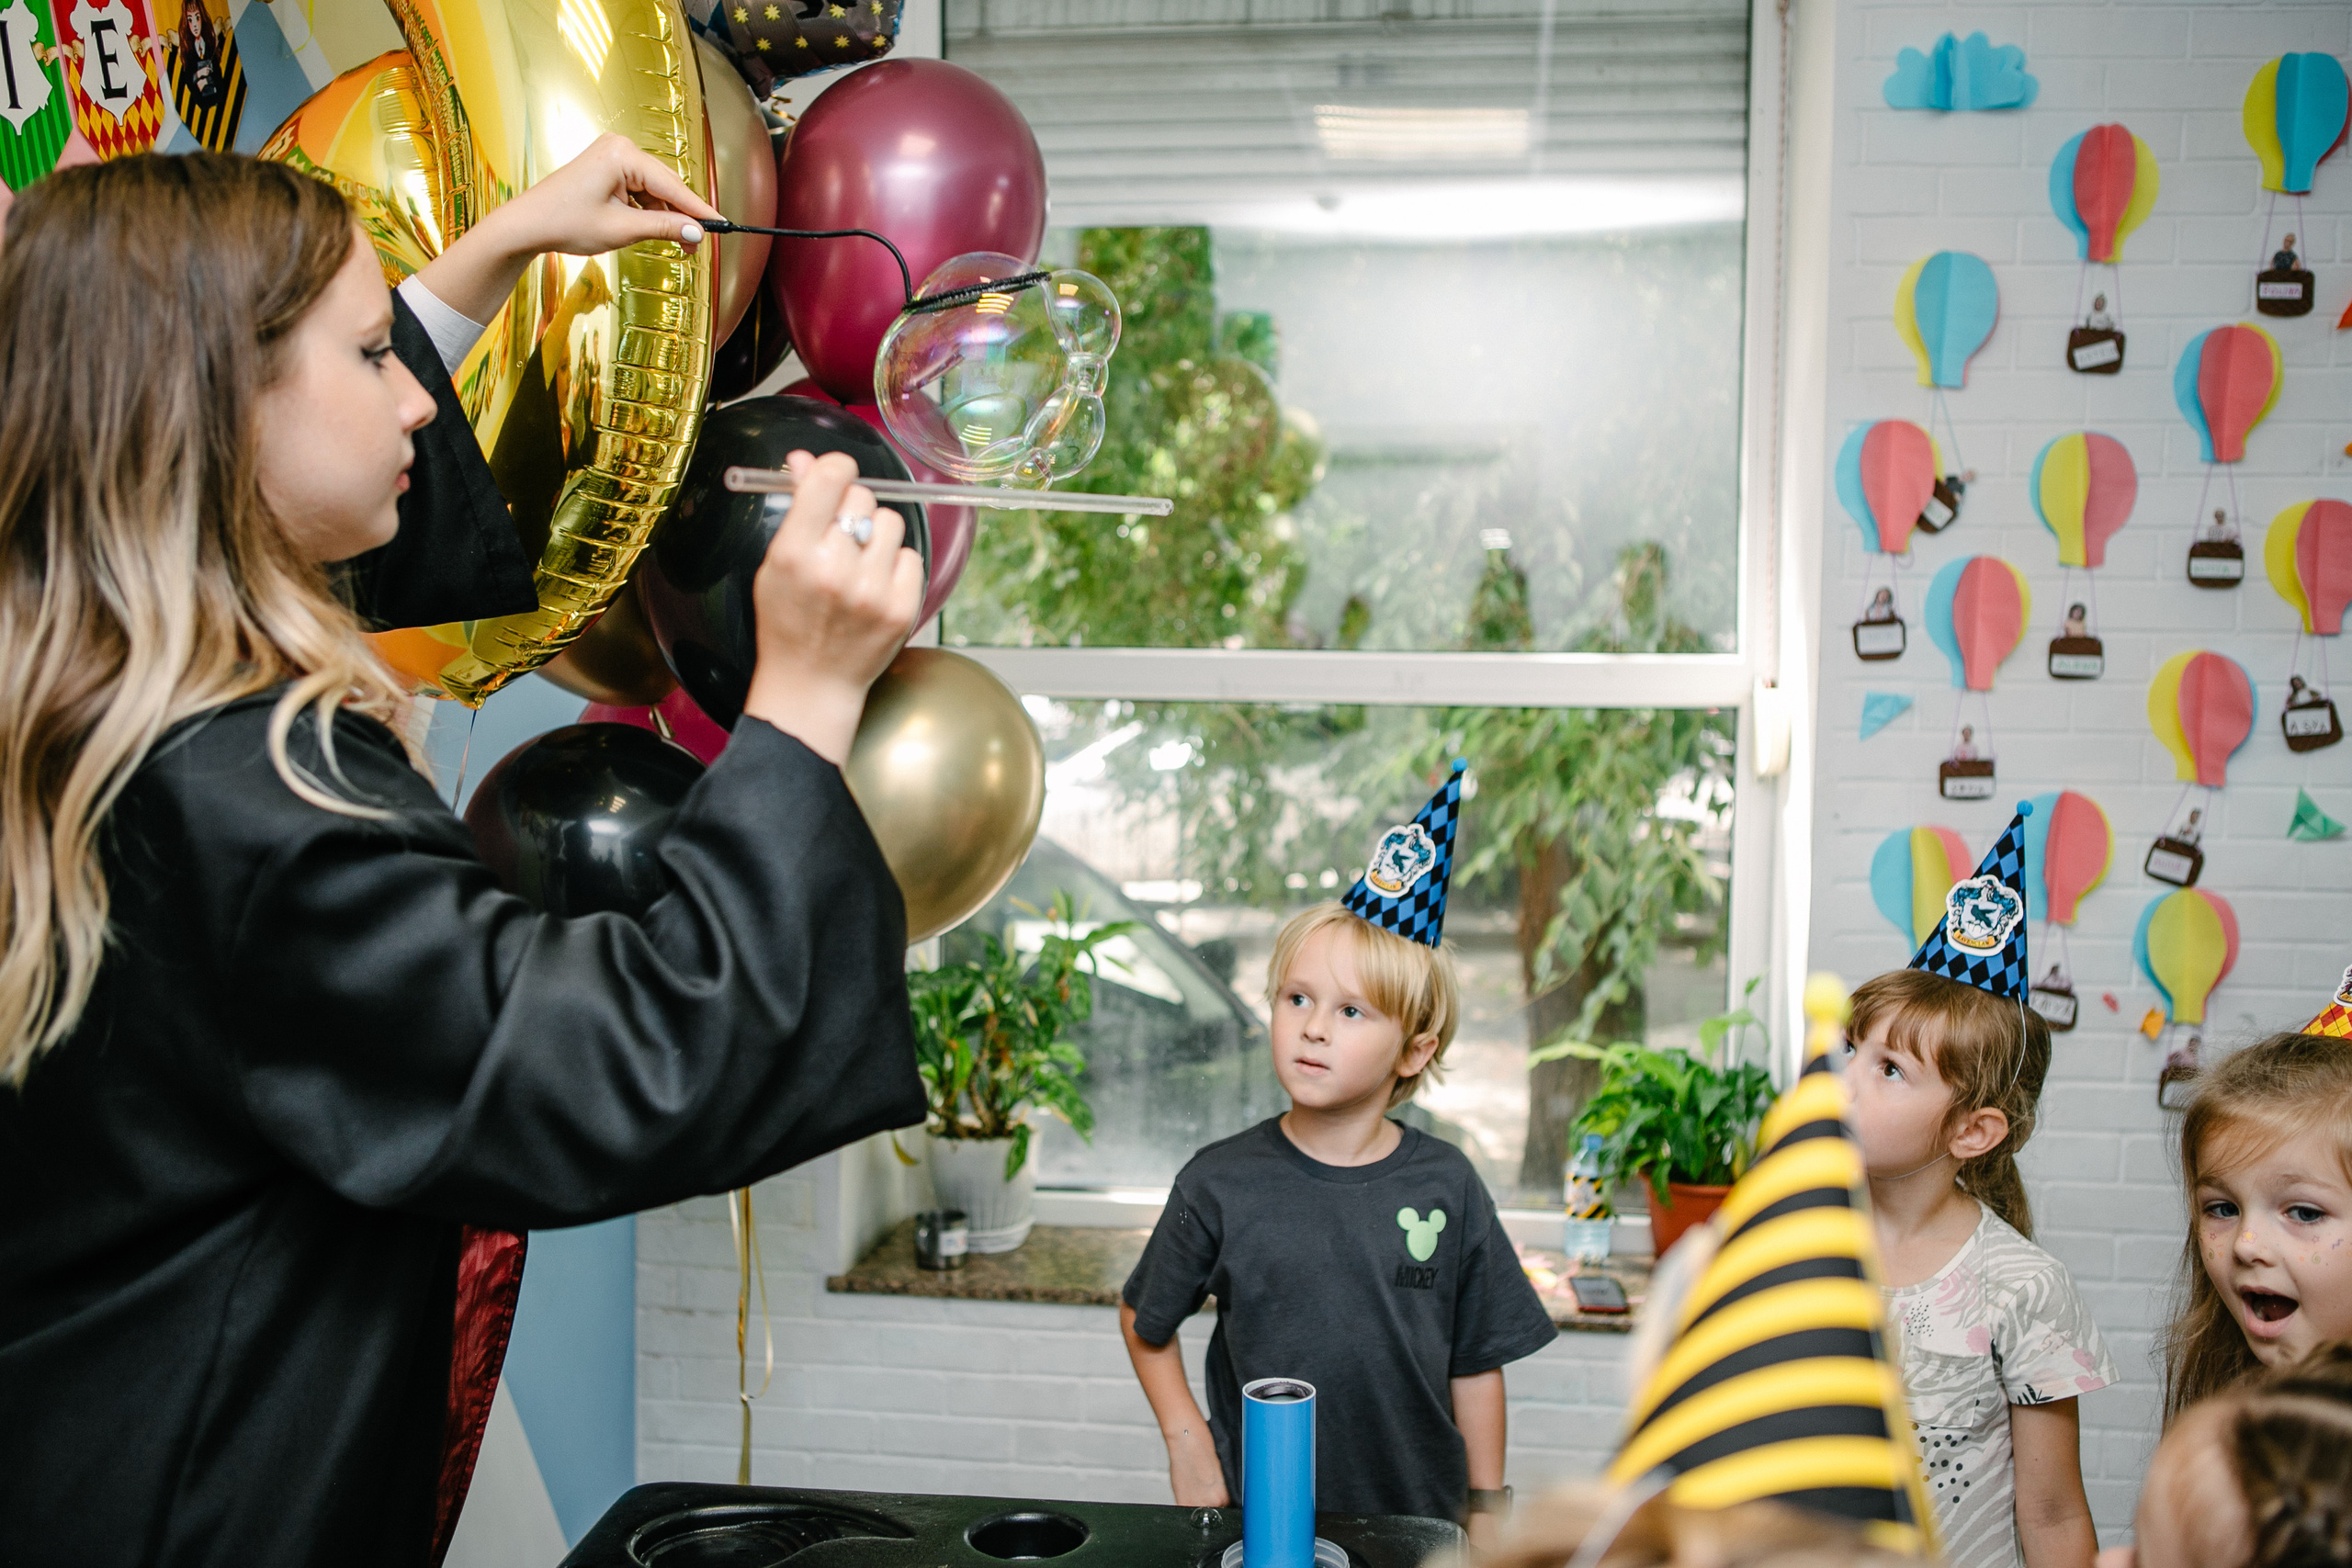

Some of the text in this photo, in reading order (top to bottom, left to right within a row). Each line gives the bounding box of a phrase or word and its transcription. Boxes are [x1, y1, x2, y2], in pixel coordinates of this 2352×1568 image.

[90, 17, 128, 100] E
[1957, 933, 1990, 946] RAVENCLAW
[1395, 1263, 1439, 1290] MICKEY
